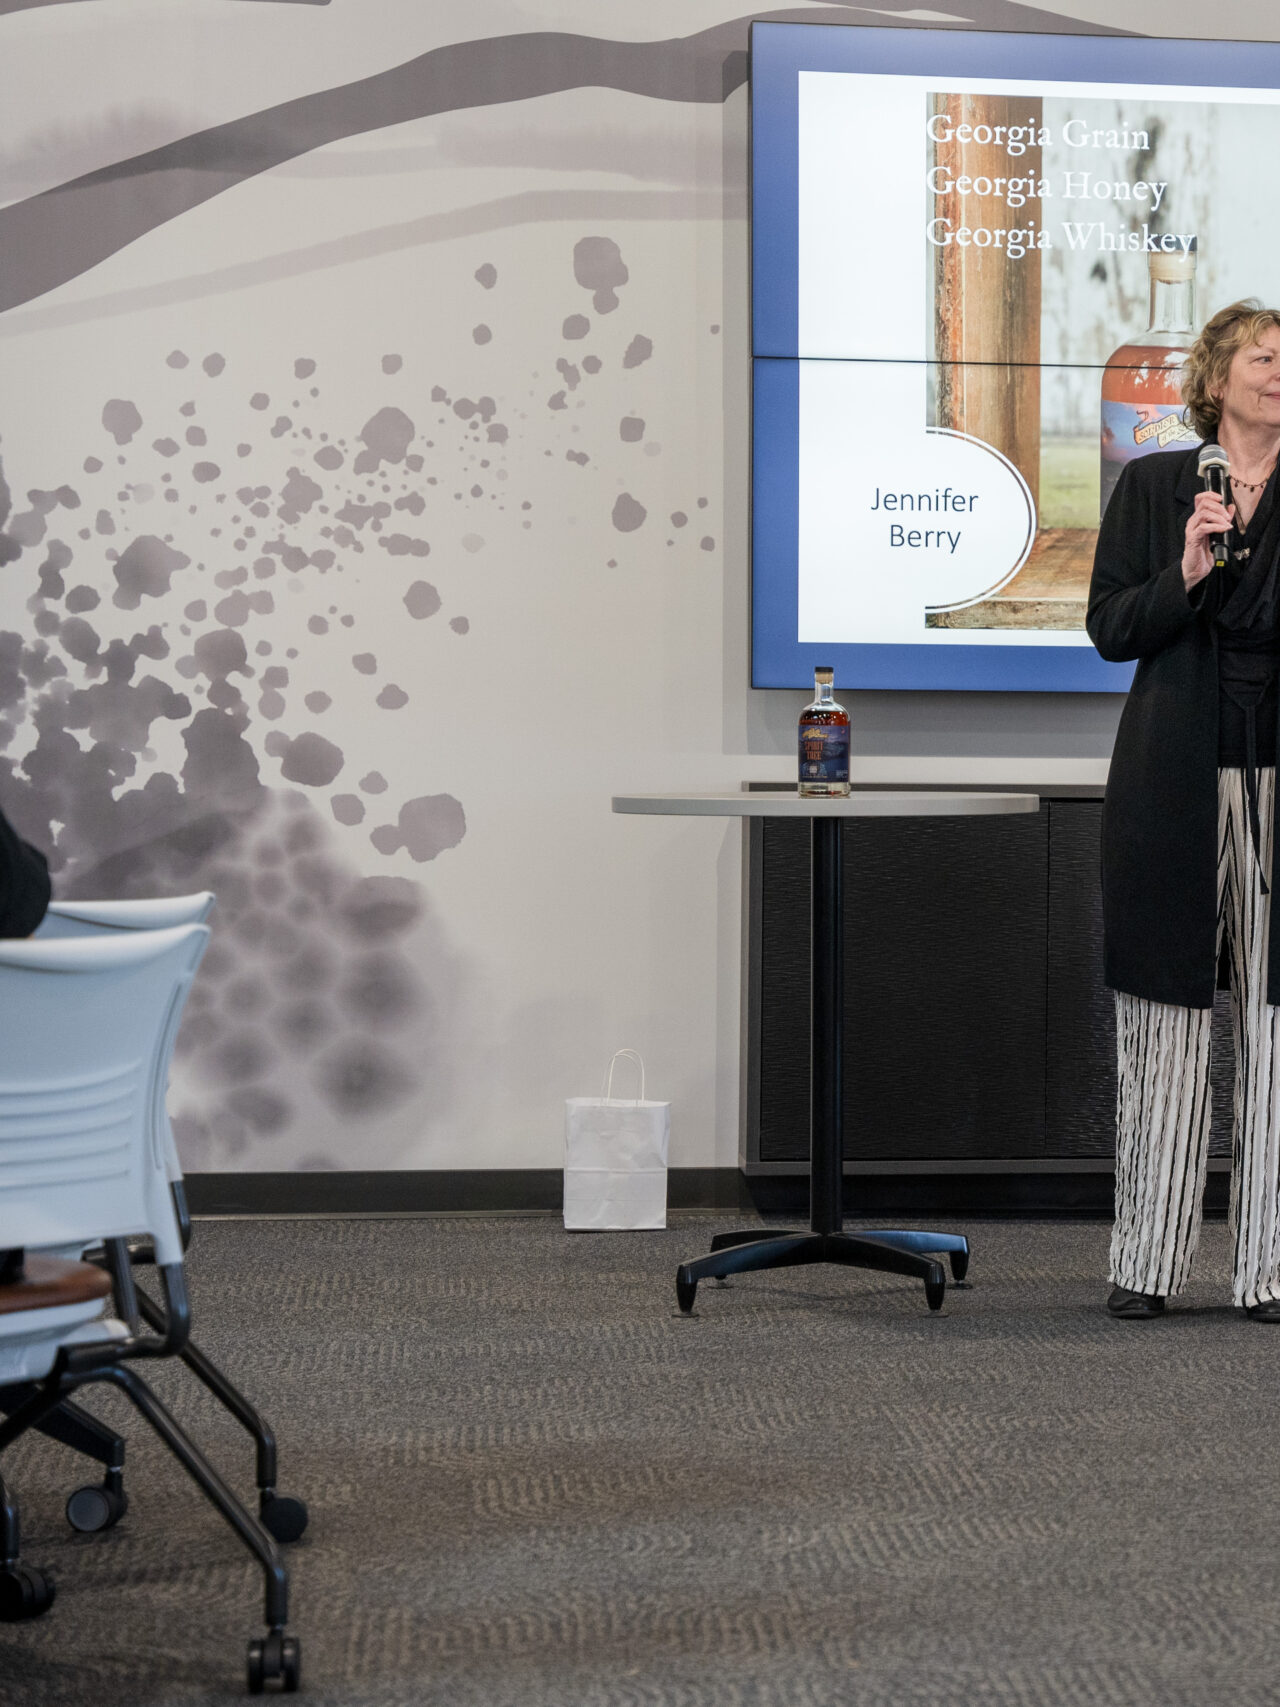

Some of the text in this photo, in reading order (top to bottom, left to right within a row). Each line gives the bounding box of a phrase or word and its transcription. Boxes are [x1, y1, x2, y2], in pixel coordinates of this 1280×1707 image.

[926, 114, 1150, 156] Georgia Grain
[926, 166, 1168, 211] Georgia Honey
[926, 217, 1197, 262] Georgia Whiskey
[870, 487, 979, 512] Jennifer
[890, 524, 962, 554] Berry
